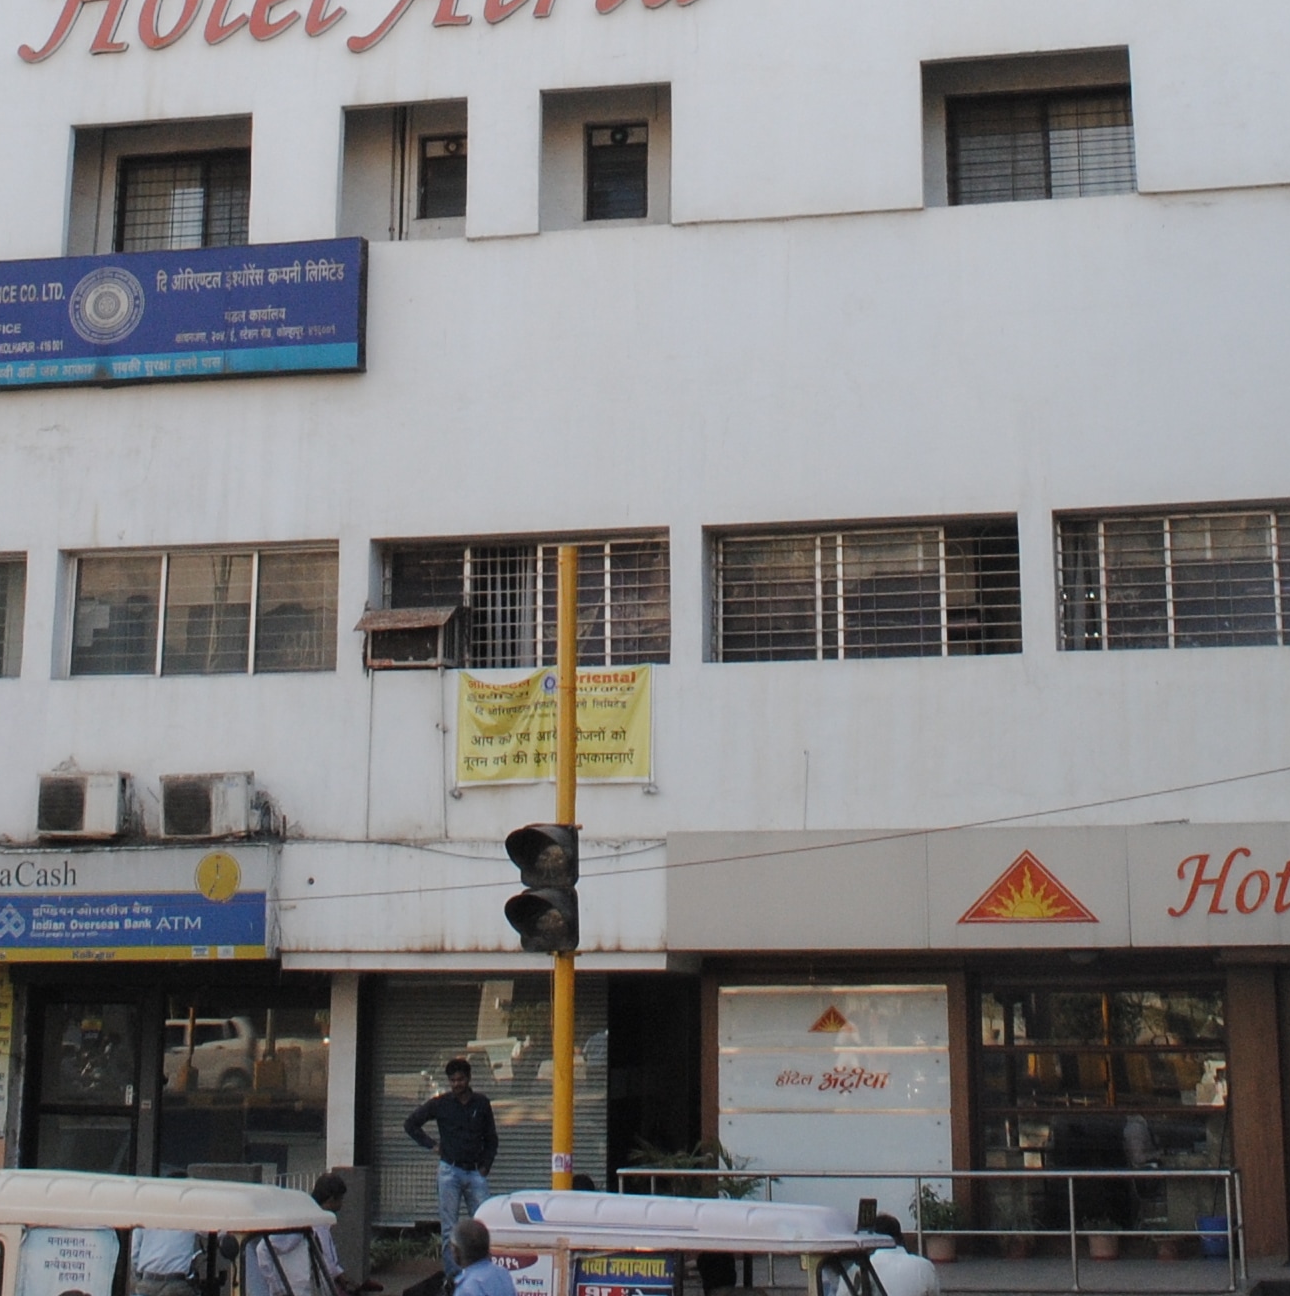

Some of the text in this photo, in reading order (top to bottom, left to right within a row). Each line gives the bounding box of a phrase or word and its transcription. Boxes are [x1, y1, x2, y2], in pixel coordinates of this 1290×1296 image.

[305, 258, 345, 282] लिमिटेड
[20, 284, 39, 303] CO.
[42, 282, 66, 302] LTD.
[574, 672, 636, 684] riental
[611, 726, 627, 742] को
[513, 750, 528, 764] की
[32, 916, 202, 931] Indian Overseas Bank ATM
